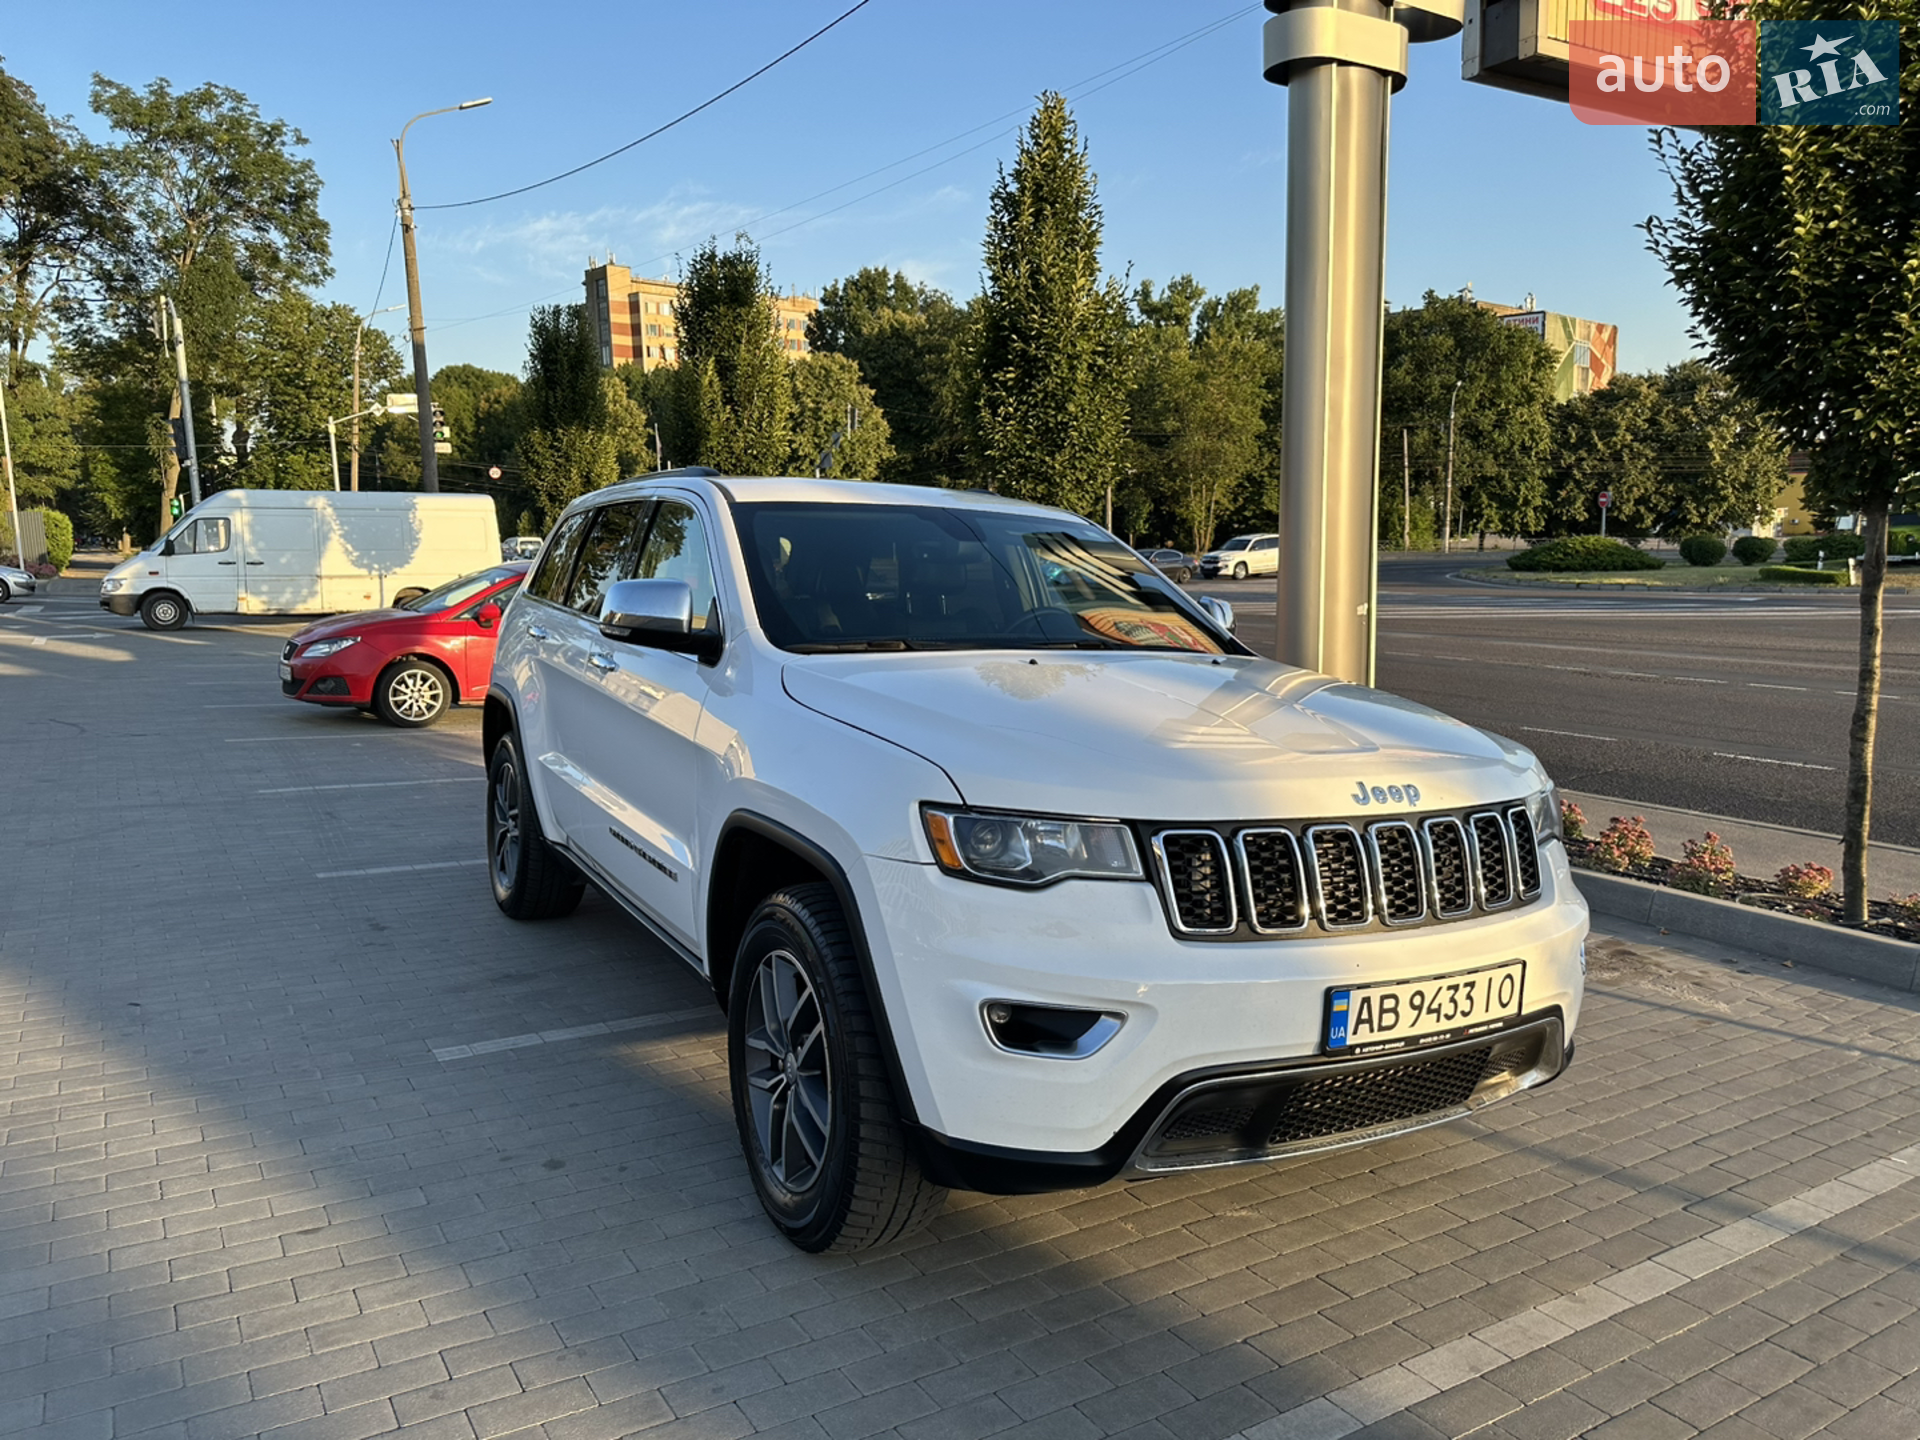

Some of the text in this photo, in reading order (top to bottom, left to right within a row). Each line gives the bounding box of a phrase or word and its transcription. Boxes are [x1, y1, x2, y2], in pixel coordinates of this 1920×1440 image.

[1350, 781, 1421, 807] Jeep
[1352, 992, 1401, 1036] AB
[1408, 980, 1477, 1028] 9433
[1330, 1026, 1346, 1040] UA
